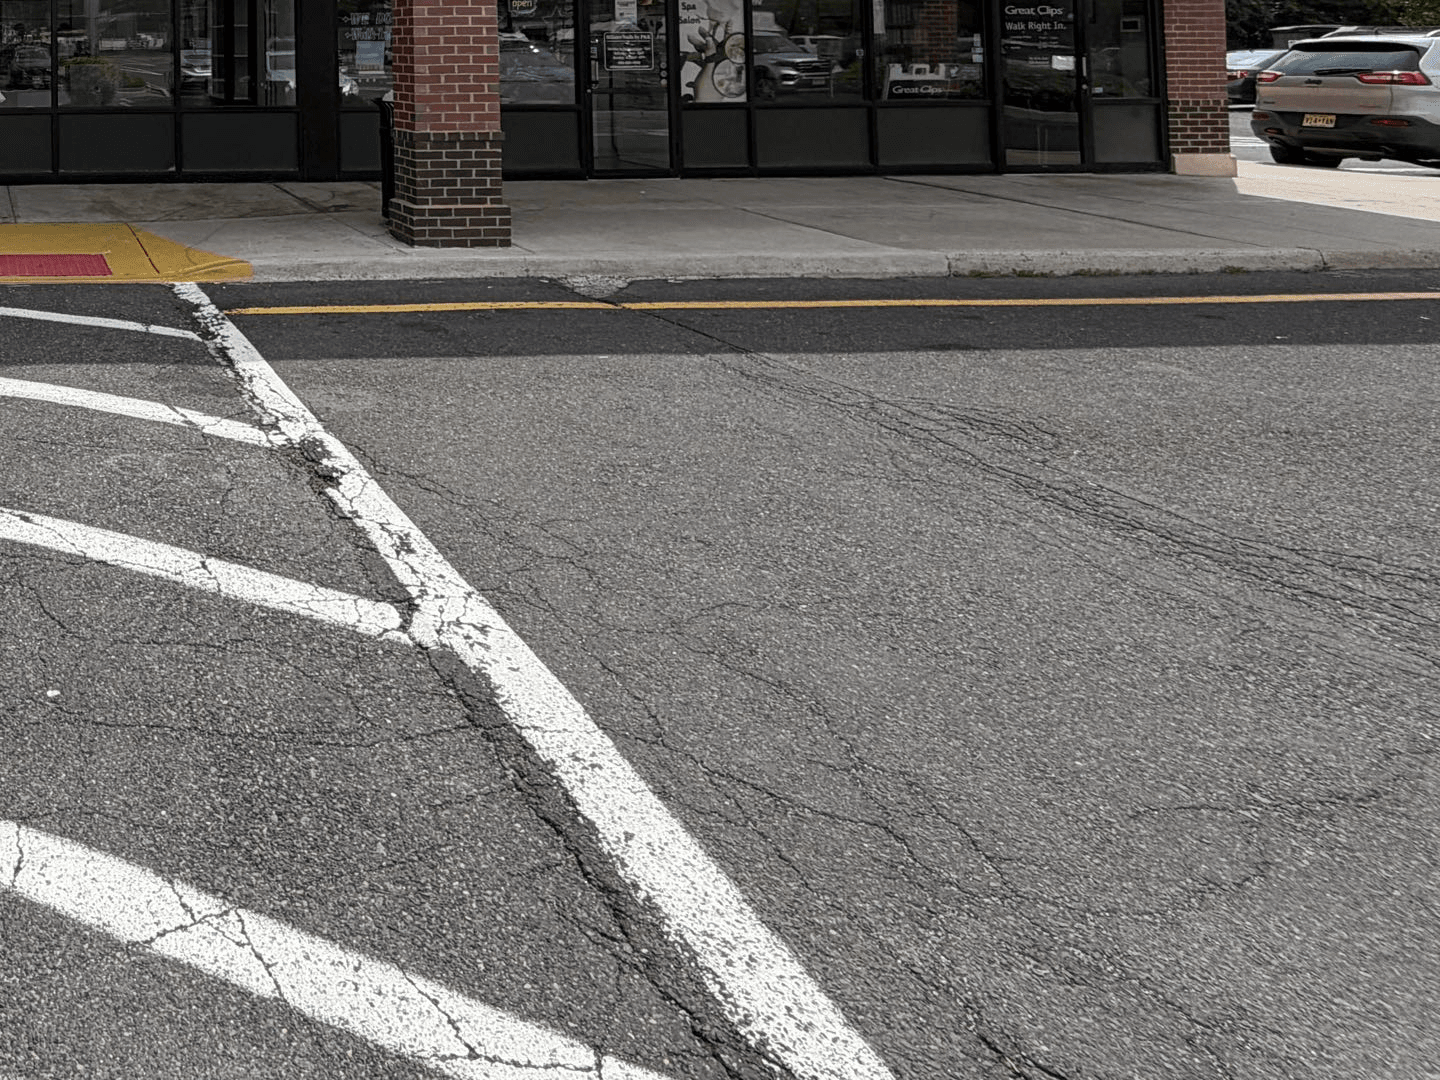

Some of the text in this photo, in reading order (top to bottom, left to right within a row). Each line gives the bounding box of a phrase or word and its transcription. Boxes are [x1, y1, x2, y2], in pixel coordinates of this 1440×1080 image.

[681, 1, 697, 11] Spa
[1004, 4, 1064, 17] Great Clips
[1005, 21, 1026, 31] Walk
[1028, 21, 1051, 32] Right
[892, 85, 919, 94] Great
